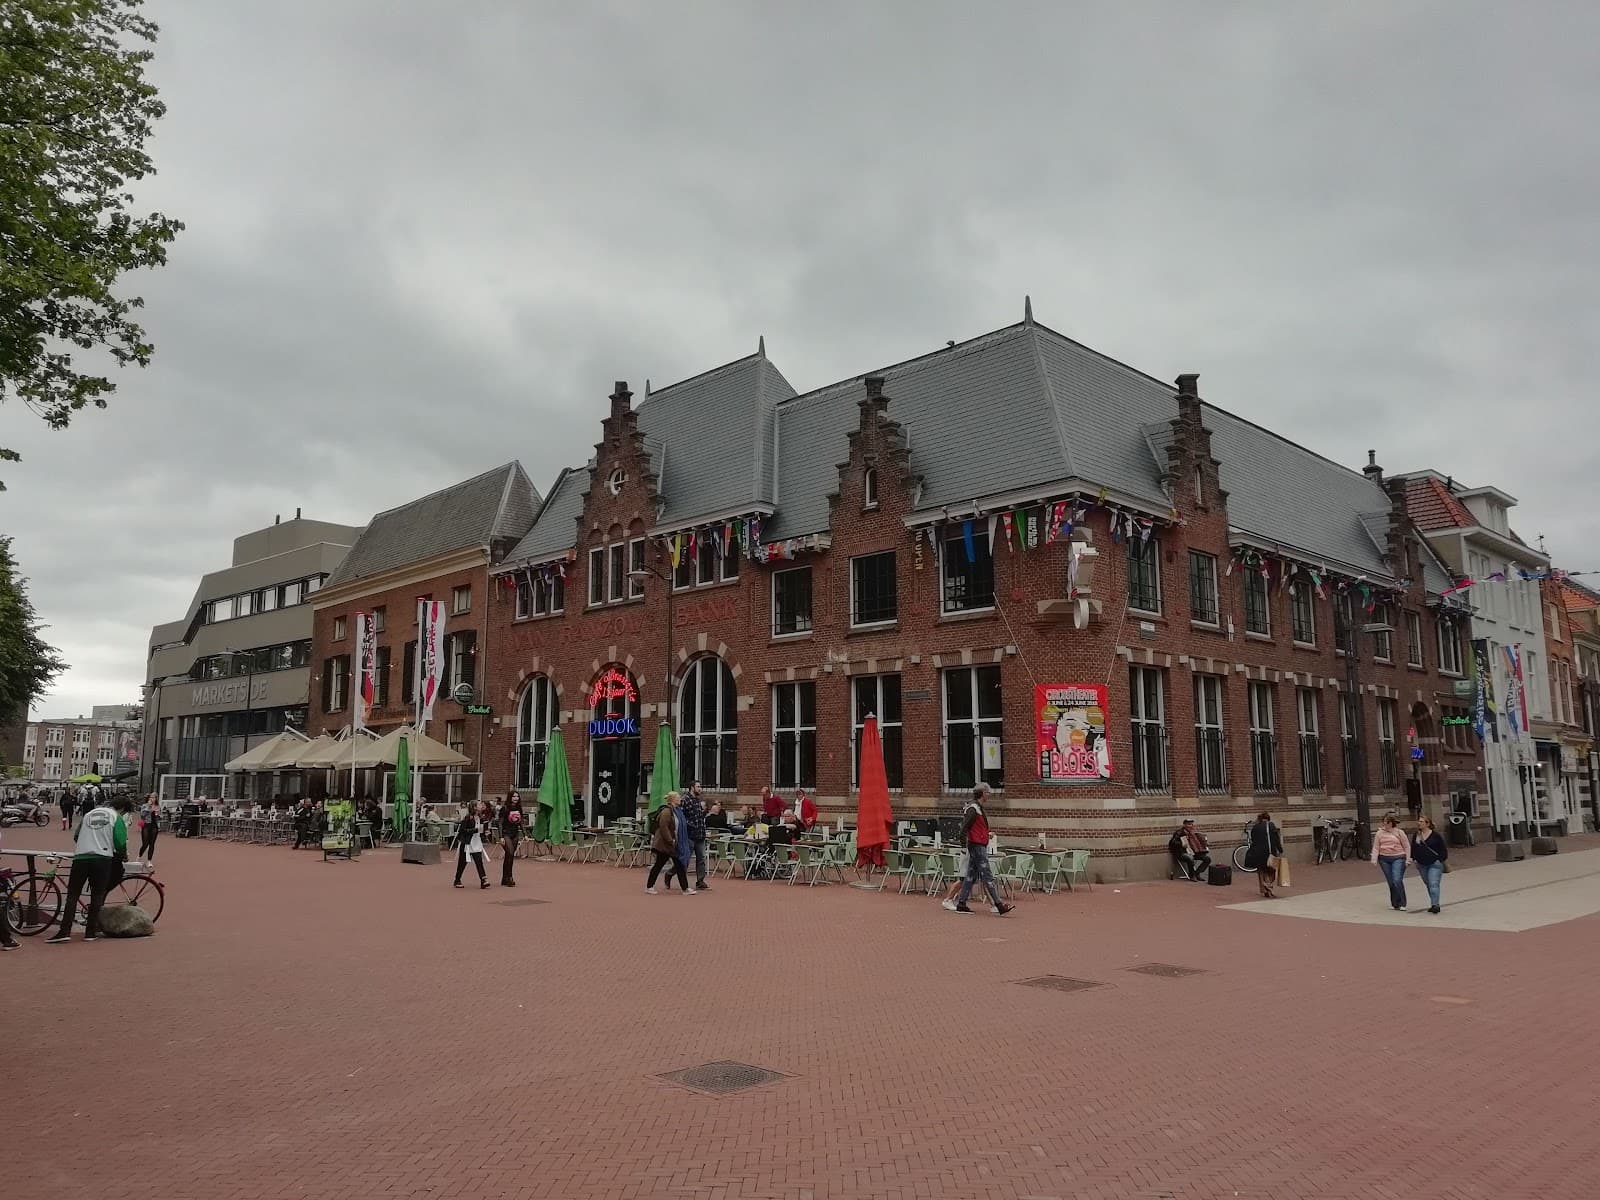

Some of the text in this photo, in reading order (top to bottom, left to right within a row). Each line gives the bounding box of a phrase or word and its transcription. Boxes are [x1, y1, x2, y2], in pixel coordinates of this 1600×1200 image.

[676, 601, 738, 628] BANK
[192, 680, 268, 706] MARKETSDE
[589, 718, 635, 734] DUDOK
